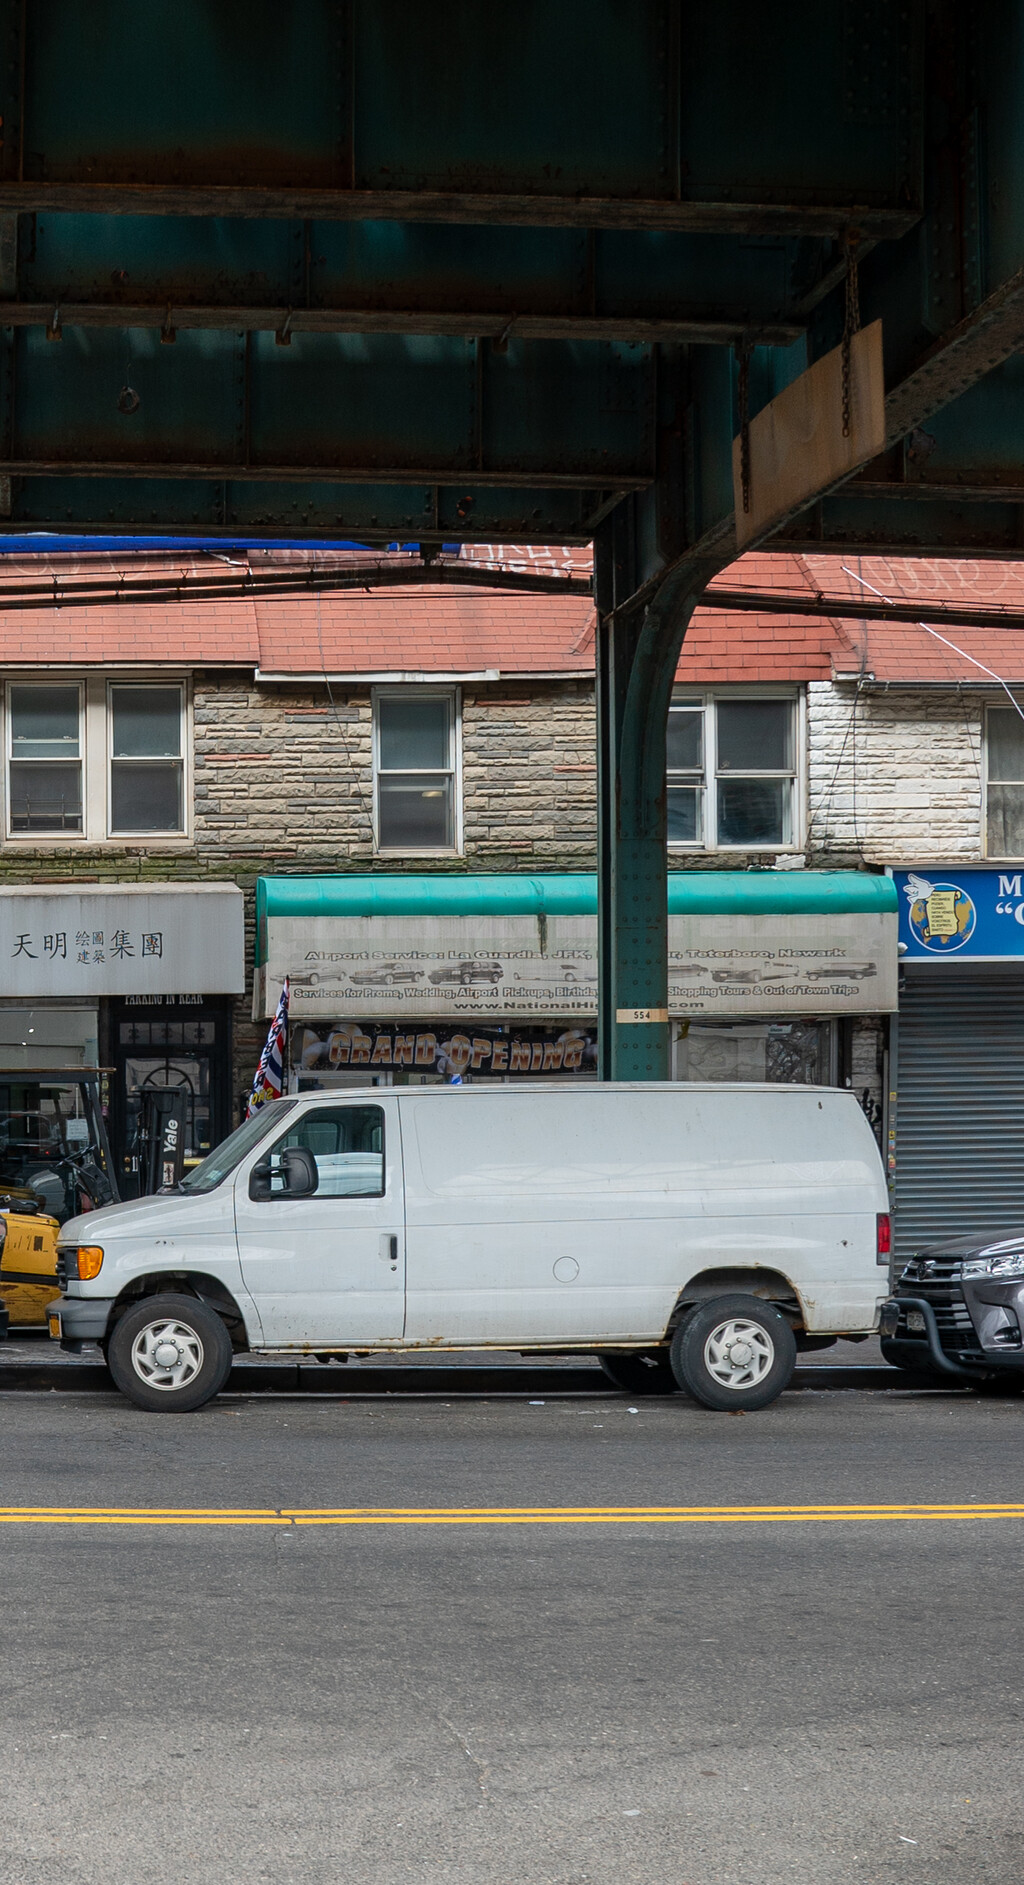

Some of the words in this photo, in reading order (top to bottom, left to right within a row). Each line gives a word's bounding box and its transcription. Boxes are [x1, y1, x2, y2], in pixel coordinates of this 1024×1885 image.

[305, 950, 369, 962] Airport
[371, 950, 445, 960] Service:
[448, 950, 472, 960] La
[475, 949, 548, 961] Guardia,
[552, 949, 592, 960] JFK,
[686, 948, 776, 959] Teterboro,
[778, 948, 847, 958] Newark
[294, 988, 343, 999] Services
[344, 988, 363, 999] for
[363, 988, 404, 1000] Proms,
[404, 987, 456, 1000] Wedding,
[457, 987, 499, 999] Airport
[502, 987, 554, 999] Pickups,
[667, 986, 718, 998] Shopping
[719, 985, 751, 996] Tours
[752, 986, 763, 996] &
[764, 985, 786, 996] Out
[787, 985, 800, 995] of
[799, 985, 830, 995] Town
[831, 984, 860, 996] Trips
[633, 1010, 651, 1020] 554
[329, 1033, 437, 1064] GRAND
[449, 1033, 586, 1071] OPENING
[163, 1118, 179, 1153] Yale
